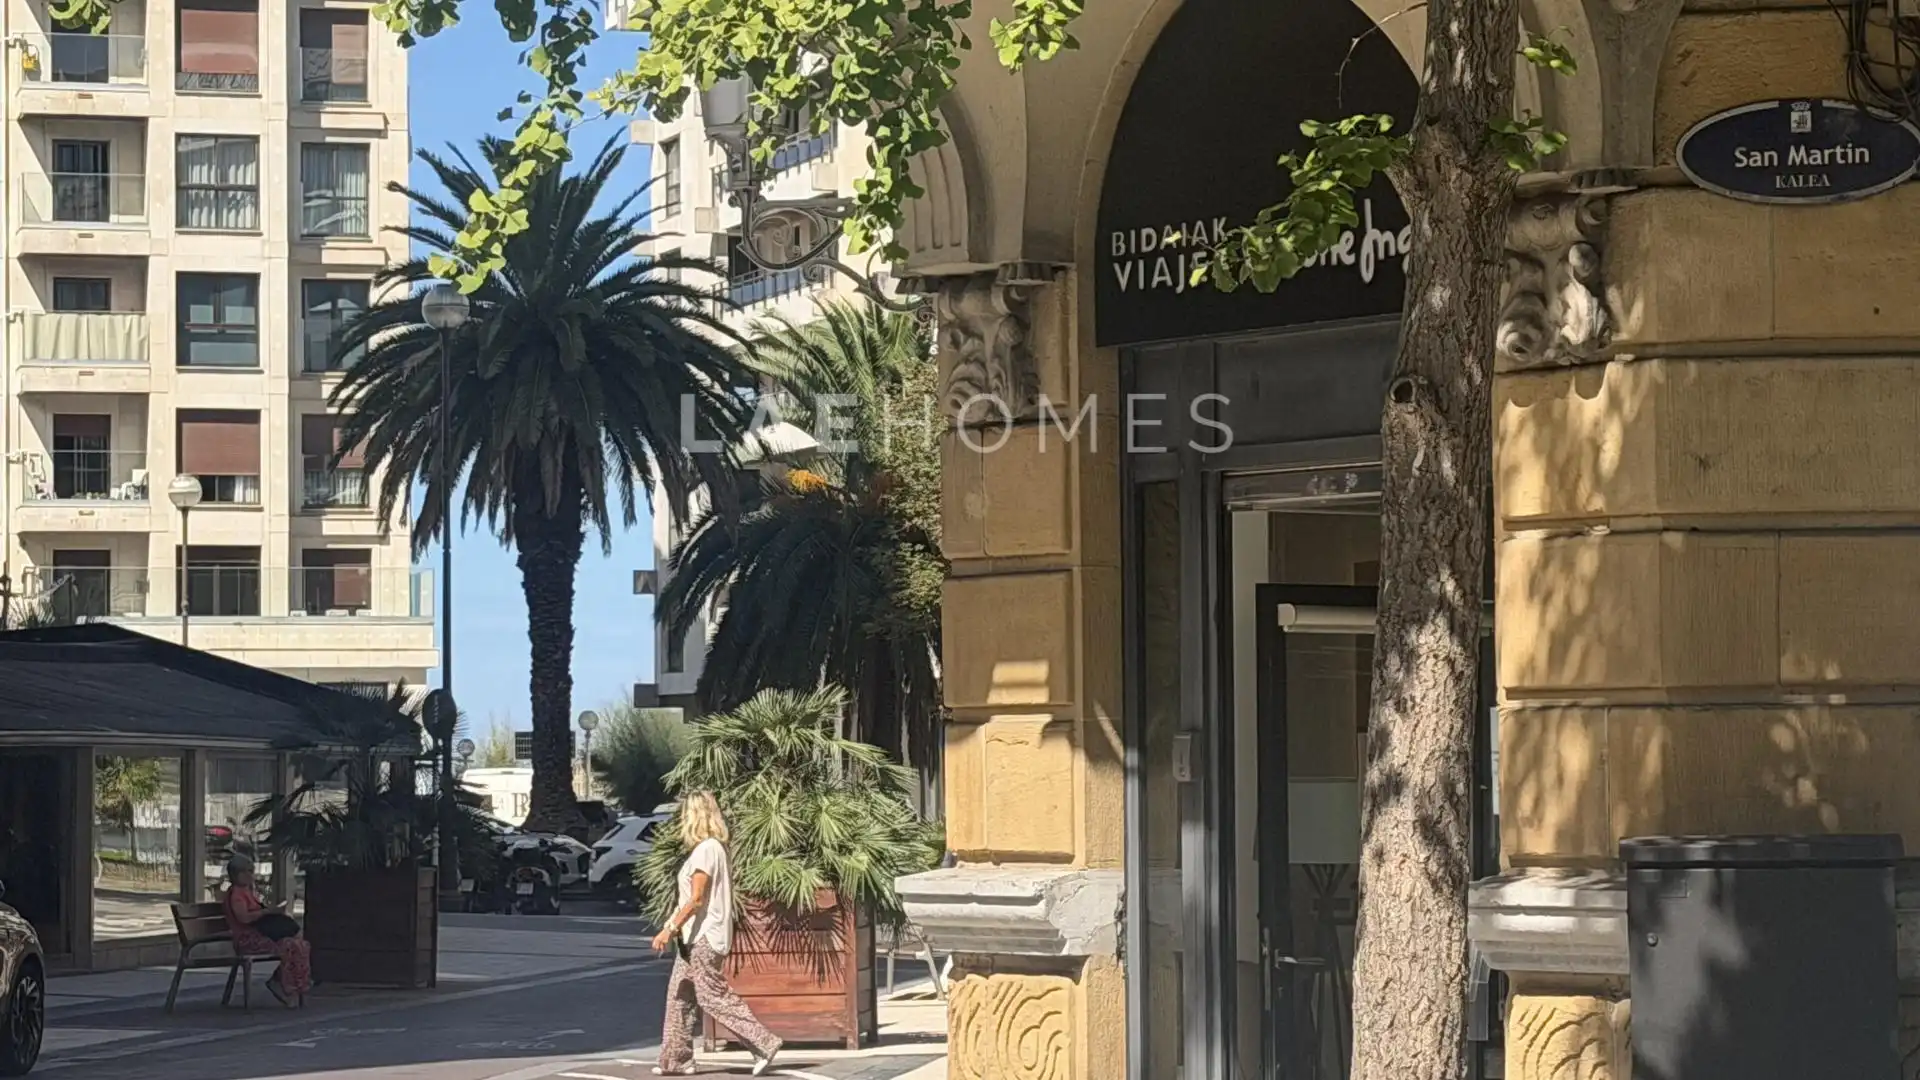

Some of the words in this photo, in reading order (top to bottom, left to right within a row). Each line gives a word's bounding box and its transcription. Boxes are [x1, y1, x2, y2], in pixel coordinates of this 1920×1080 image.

[1733, 147, 1779, 168] San
[1787, 143, 1870, 166] Martin
[1775, 173, 1831, 188] KALEA
[1111, 216, 1229, 257] BIDAIAK
[1113, 251, 1209, 294] VIAJE
